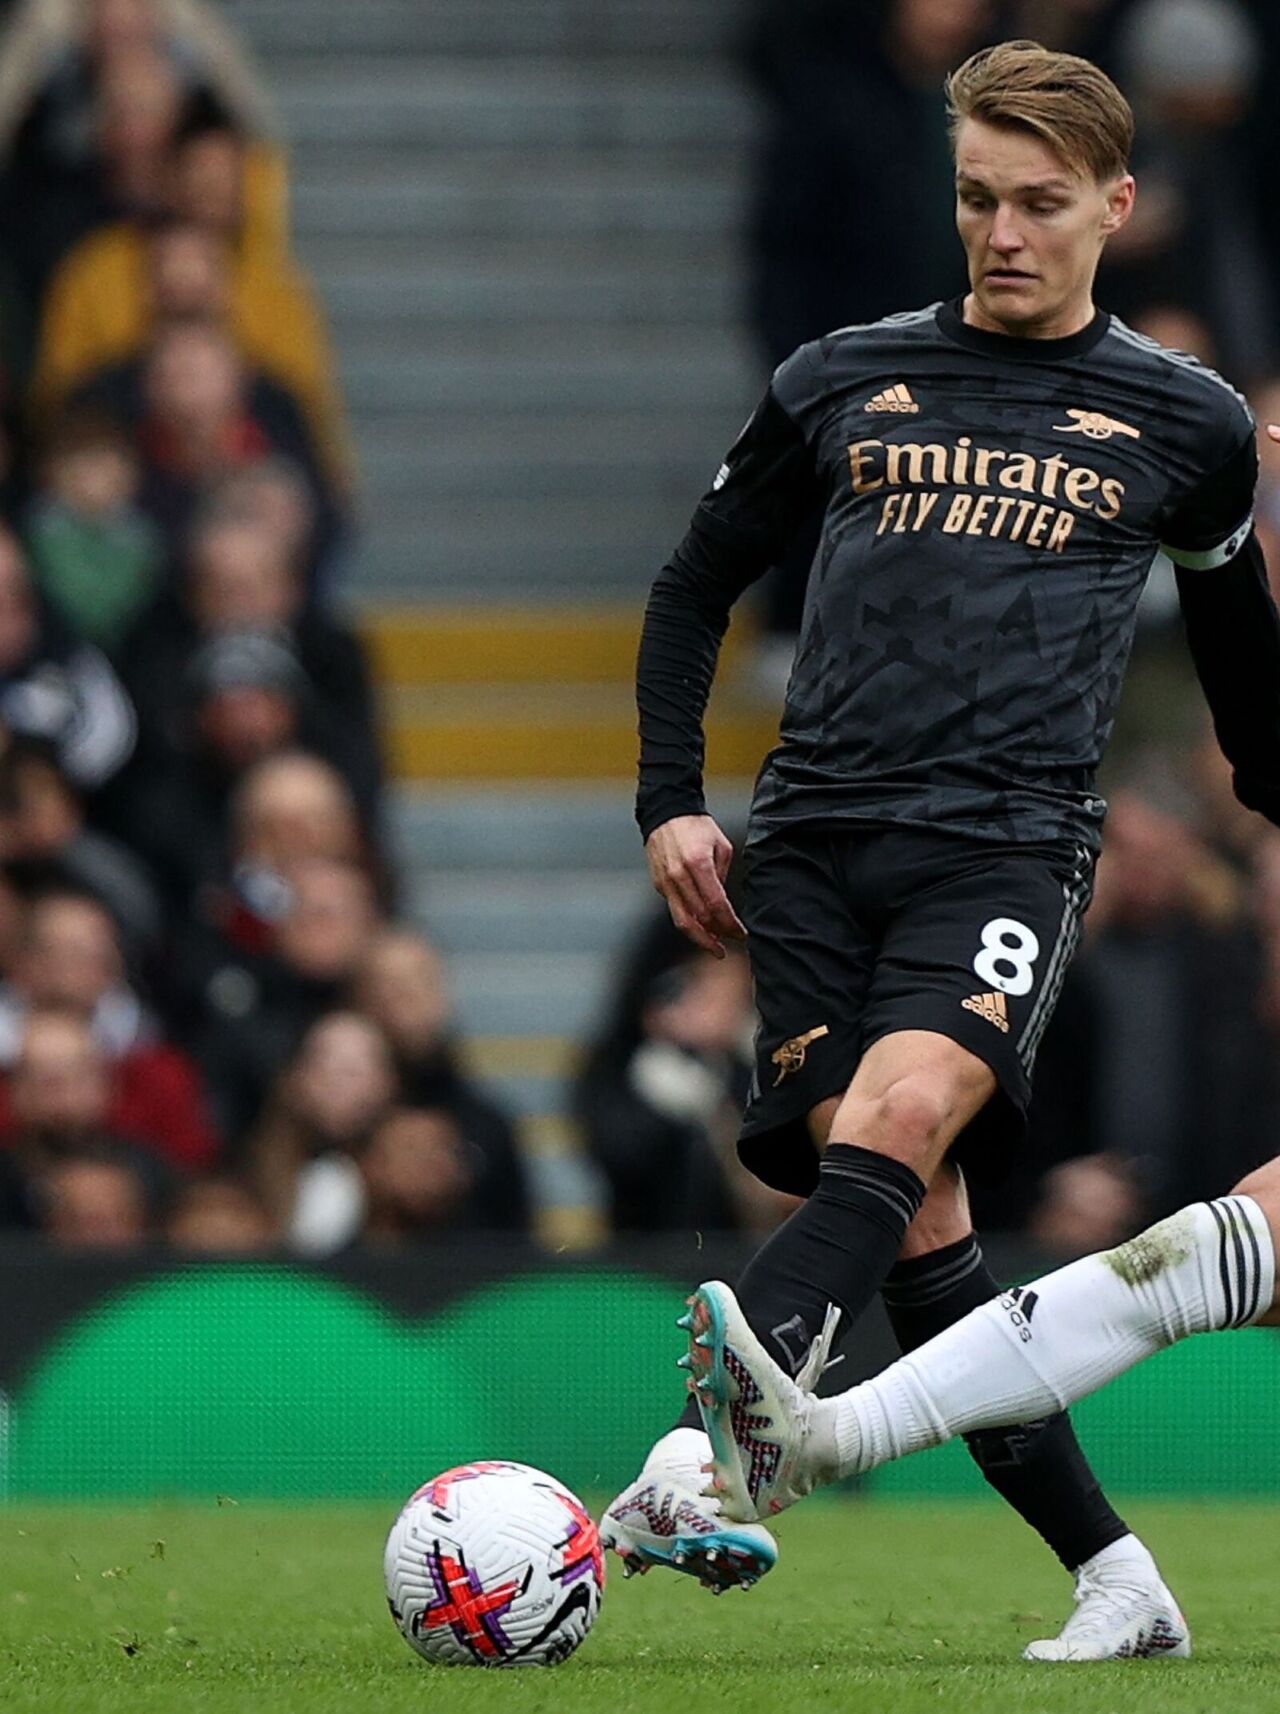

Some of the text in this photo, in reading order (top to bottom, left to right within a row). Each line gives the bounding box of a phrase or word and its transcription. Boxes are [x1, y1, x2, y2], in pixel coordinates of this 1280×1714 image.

[848, 436, 1125, 520] Emirates
[875, 492, 1076, 553] FLY BETTER
[973, 917, 1039, 996] 8
[961, 998, 1010, 1034] adidas
